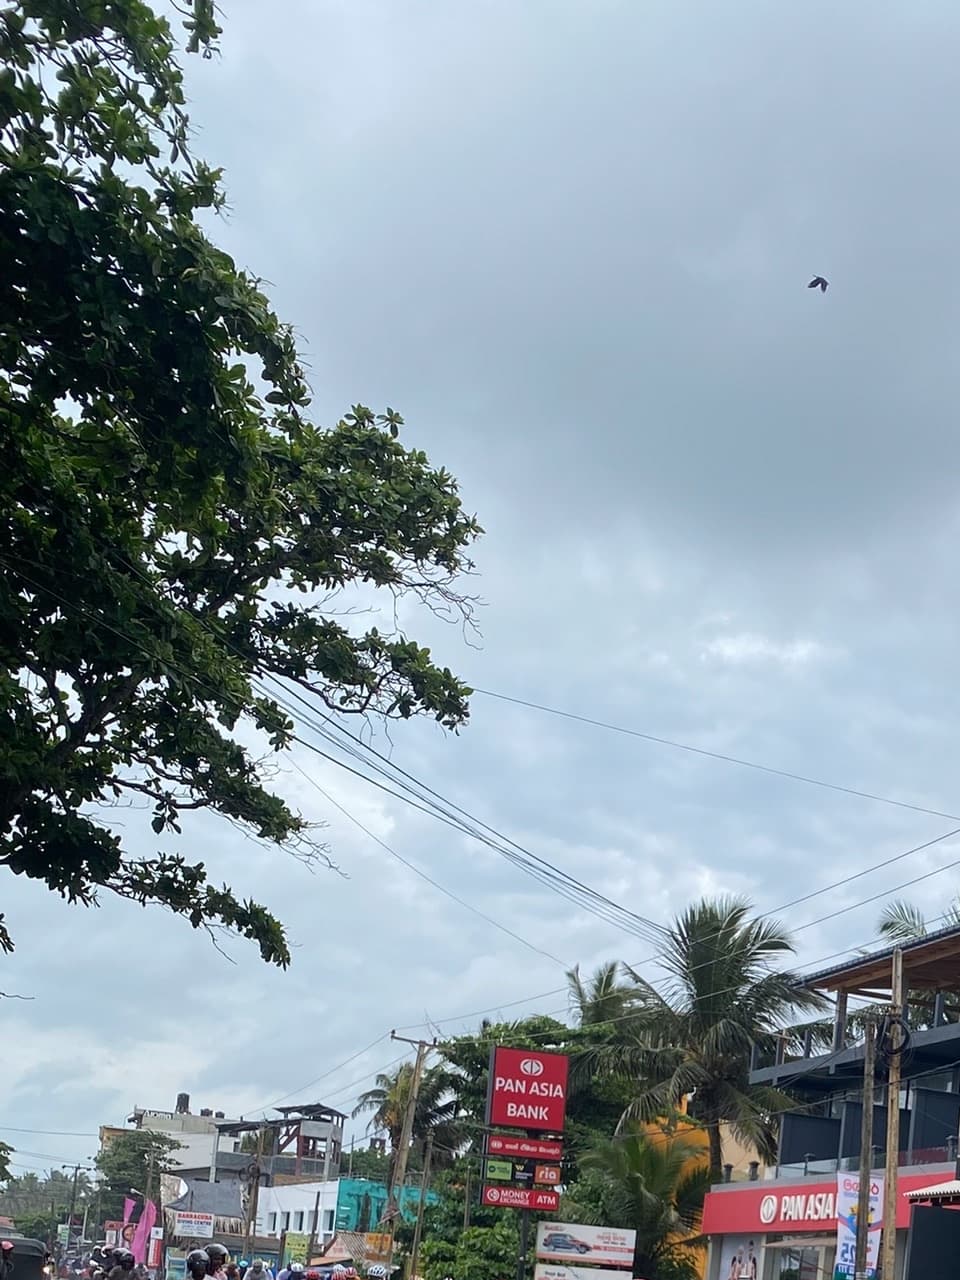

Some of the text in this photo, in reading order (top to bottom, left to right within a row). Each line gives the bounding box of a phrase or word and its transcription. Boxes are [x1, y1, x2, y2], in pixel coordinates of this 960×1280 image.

[495, 1077, 564, 1098] PAN ASIA
[507, 1103, 549, 1121] BANK
[538, 1167, 557, 1179] ria
[500, 1189, 556, 1205] MONEY ATM
[780, 1194, 806, 1221] PAN
[805, 1193, 834, 1220] ASIA
